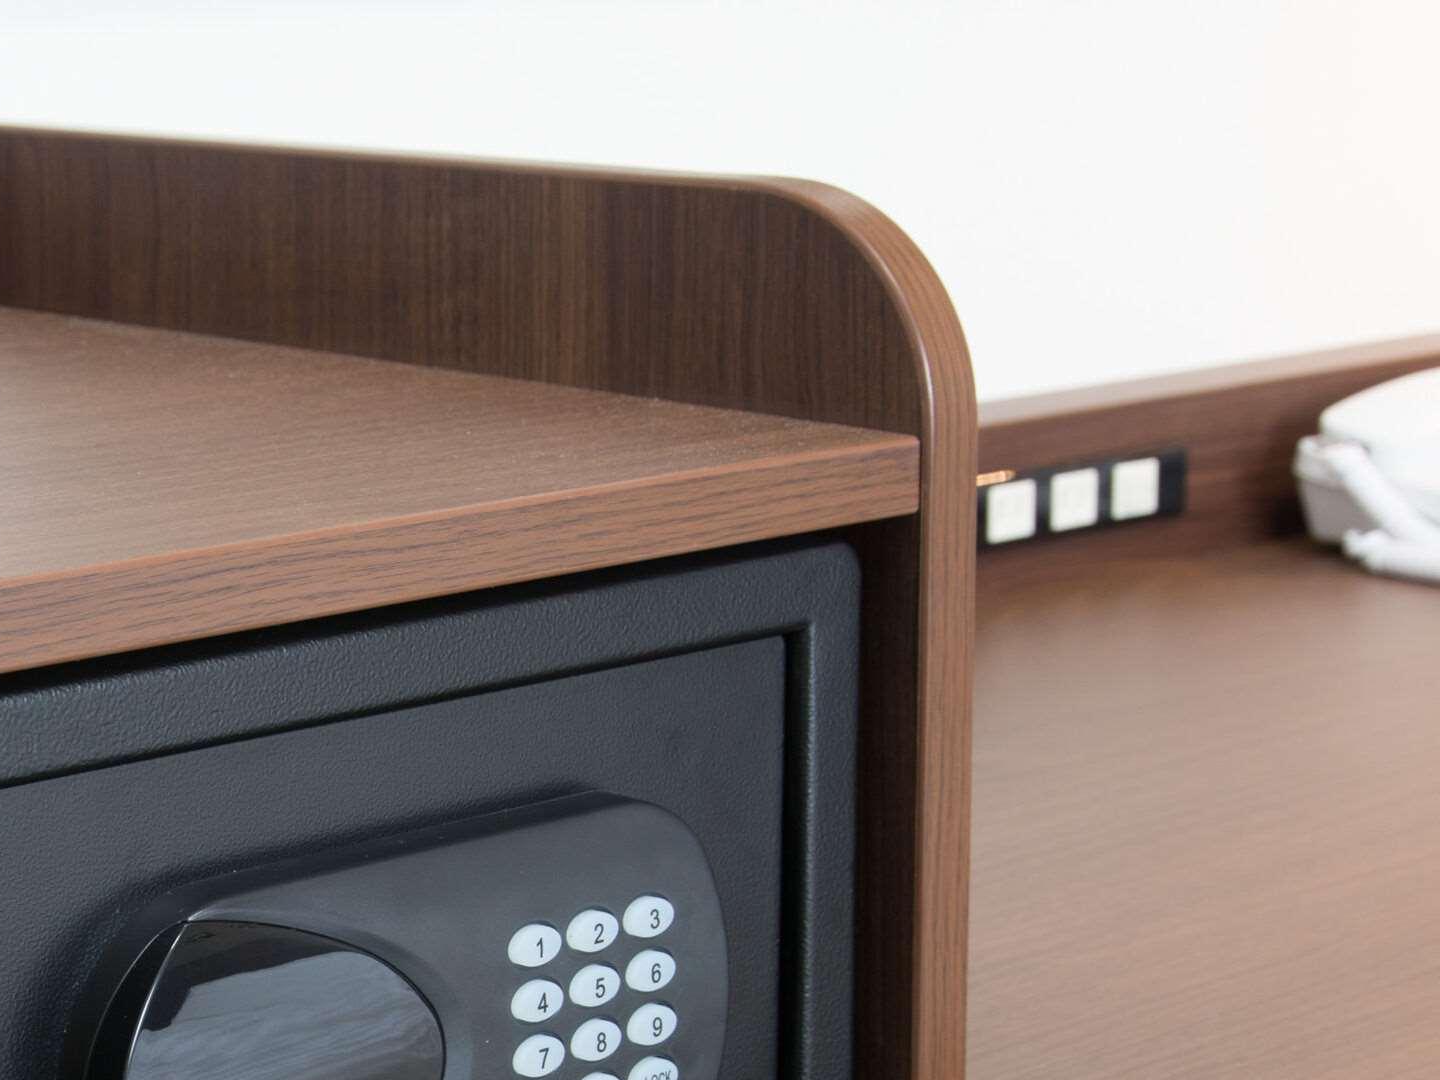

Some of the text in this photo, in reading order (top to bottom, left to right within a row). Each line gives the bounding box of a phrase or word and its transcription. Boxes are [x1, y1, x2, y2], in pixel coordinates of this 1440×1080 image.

[536, 909, 660, 958] 1 2 3
[537, 963, 661, 1013] 4 5 6
[538, 1017, 662, 1069] 7 8 9
